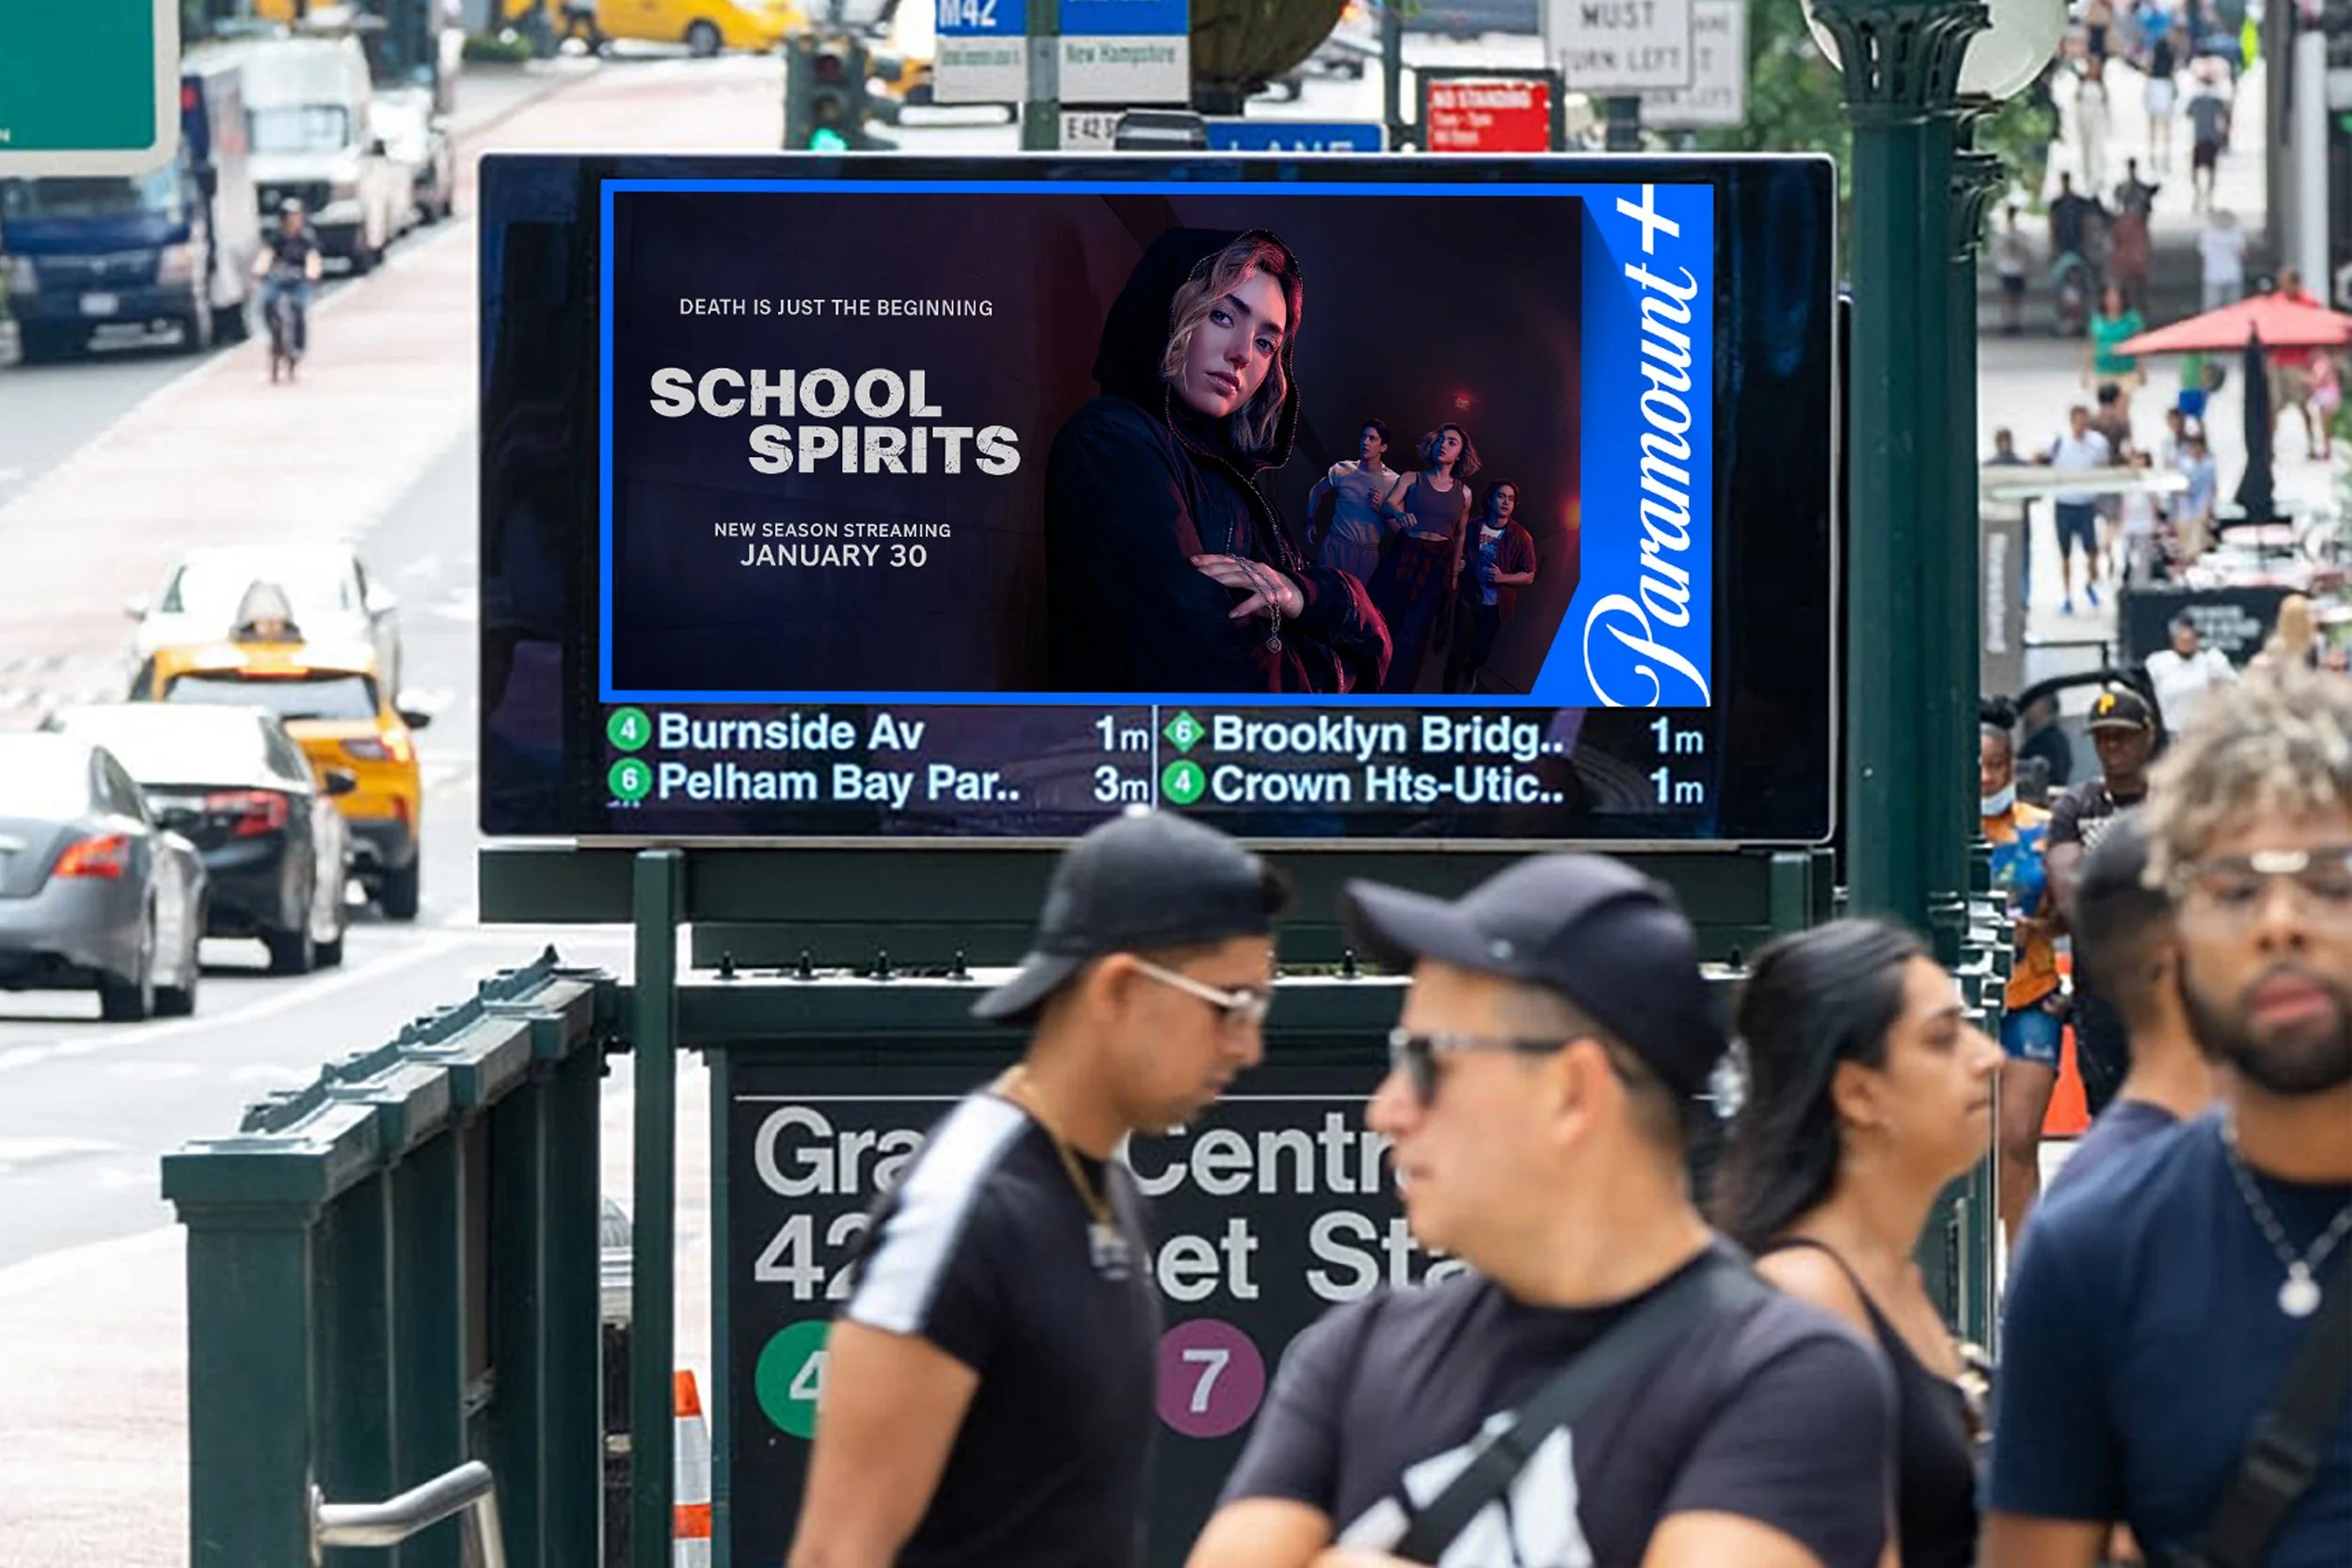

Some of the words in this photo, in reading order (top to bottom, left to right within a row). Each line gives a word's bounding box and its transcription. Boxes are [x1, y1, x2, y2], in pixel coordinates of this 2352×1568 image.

[940, 0, 996, 27] M42
[1581, 0, 1655, 29] MUST
[1627, 47, 1680, 72] LEFT
[1081, 116, 1100, 139] 42
[680, 298, 746, 316] DEATH
[754, 299, 771, 316] IS
[778, 299, 825, 316] JUST
[832, 299, 870, 316] THE
[877, 299, 993, 317] BEGINNING
[649, 367, 942, 419] SCHOOL
[748, 423, 1021, 476] SPIRITS
[1584, 184, 1710, 707] Paramount+
[714, 522, 755, 537] NEW
[762, 522, 838, 538] SEASON
[843, 523, 951, 538] STREAMING
[740, 543, 881, 567] JANUARY
[889, 544, 927, 568] 30
[621, 717, 636, 739] 4
[659, 712, 856, 751] Burnside
[867, 713, 925, 751] Av
[1095, 715, 1149, 752] 1m
[1175, 721, 1192, 743] 6
[1214, 714, 1406, 759] Brooklyn
[1422, 715, 1564, 759] Bridg..
[1650, 716, 1703, 753] 1m
[622, 768, 638, 790] 6
[659, 763, 818, 801] Pelham
[833, 763, 914, 809] Bay
[928, 764, 1020, 801] Par..
[1094, 765, 1149, 801] 3m
[1174, 768, 1191, 793] 4
[1212, 765, 1351, 802] Crown
[1366, 765, 1564, 803] Hts-Utic..
[1650, 767, 1703, 803] 1m
[755, 1106, 927, 1197] Gra
[1113, 1113, 1404, 1196] Centr
[1156, 1218, 1260, 1302] et
[788, 1350, 830, 1414] 4
[1183, 1349, 1230, 1412] 7
